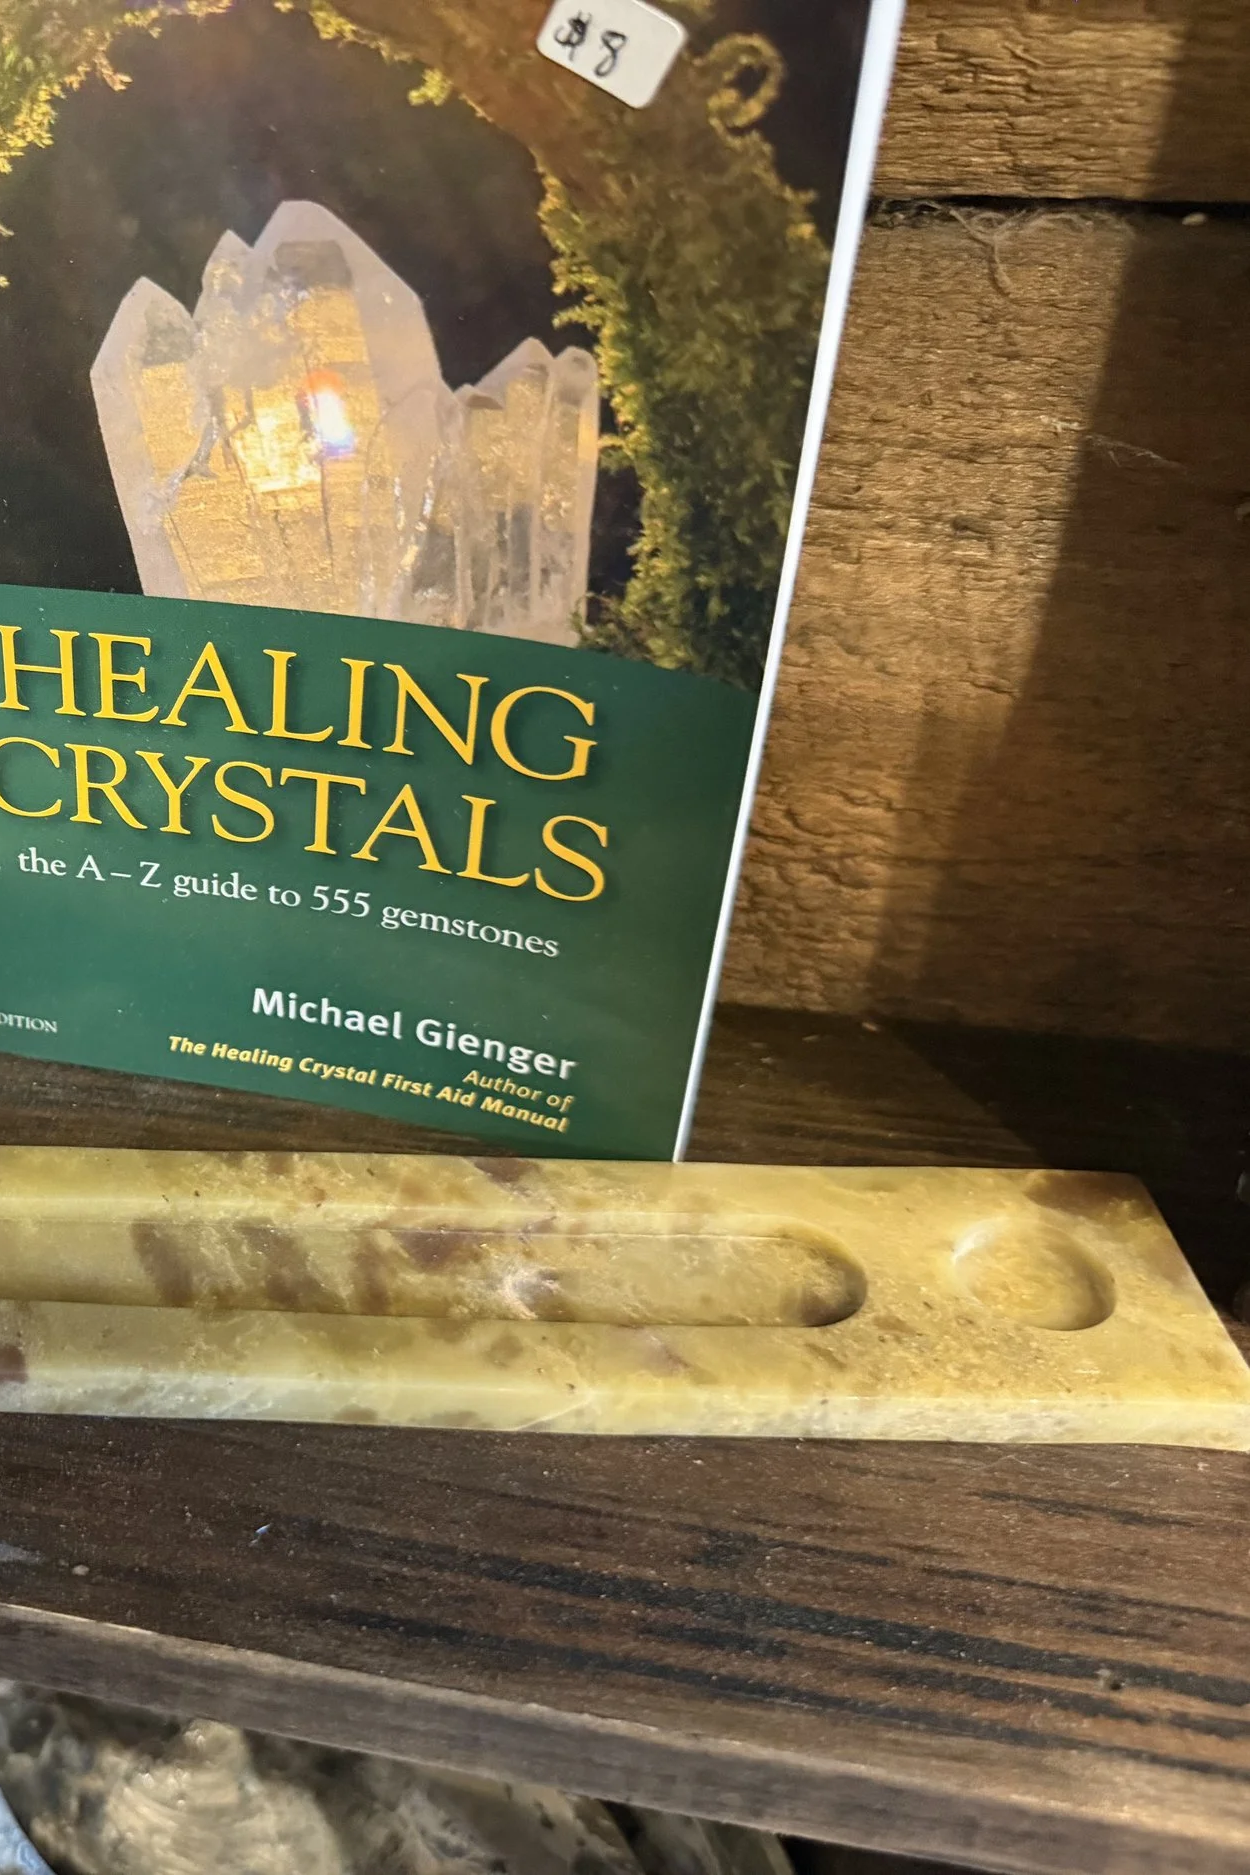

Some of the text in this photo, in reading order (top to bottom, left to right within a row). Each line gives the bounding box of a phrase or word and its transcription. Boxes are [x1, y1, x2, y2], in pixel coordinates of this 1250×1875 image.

[553, 10, 629, 78] $8
[18, 847, 68, 878] the
[173, 870, 259, 907] guide
[268, 881, 301, 909] to
[309, 885, 370, 919] 555
[381, 902, 560, 959] gemstones
[252, 987, 578, 1083] Michael Gienger
[168, 1035, 569, 1133] The Healing Crystal First Aid Manual
[462, 1068, 575, 1113] Author of
